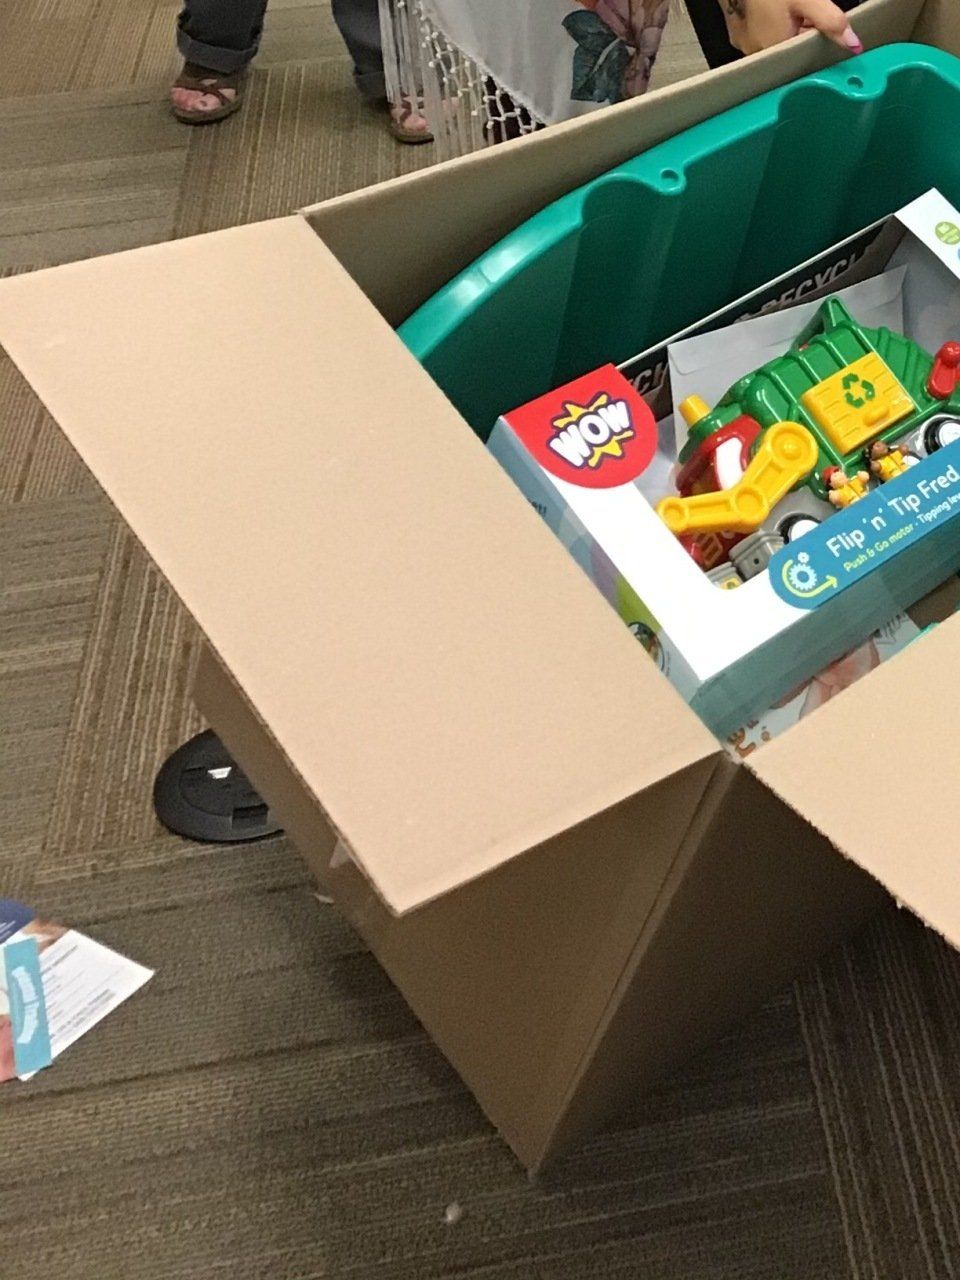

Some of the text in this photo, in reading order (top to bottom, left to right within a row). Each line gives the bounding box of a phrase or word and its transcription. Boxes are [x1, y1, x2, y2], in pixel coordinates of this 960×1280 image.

[549, 401, 631, 467] WOW
[825, 526, 866, 558] Flip
[887, 491, 922, 516] Tip
[916, 464, 960, 499] Fred
[843, 554, 867, 572] Push
[874, 540, 890, 554] Go
[889, 523, 915, 544] motor
[916, 498, 951, 524] Tipping
